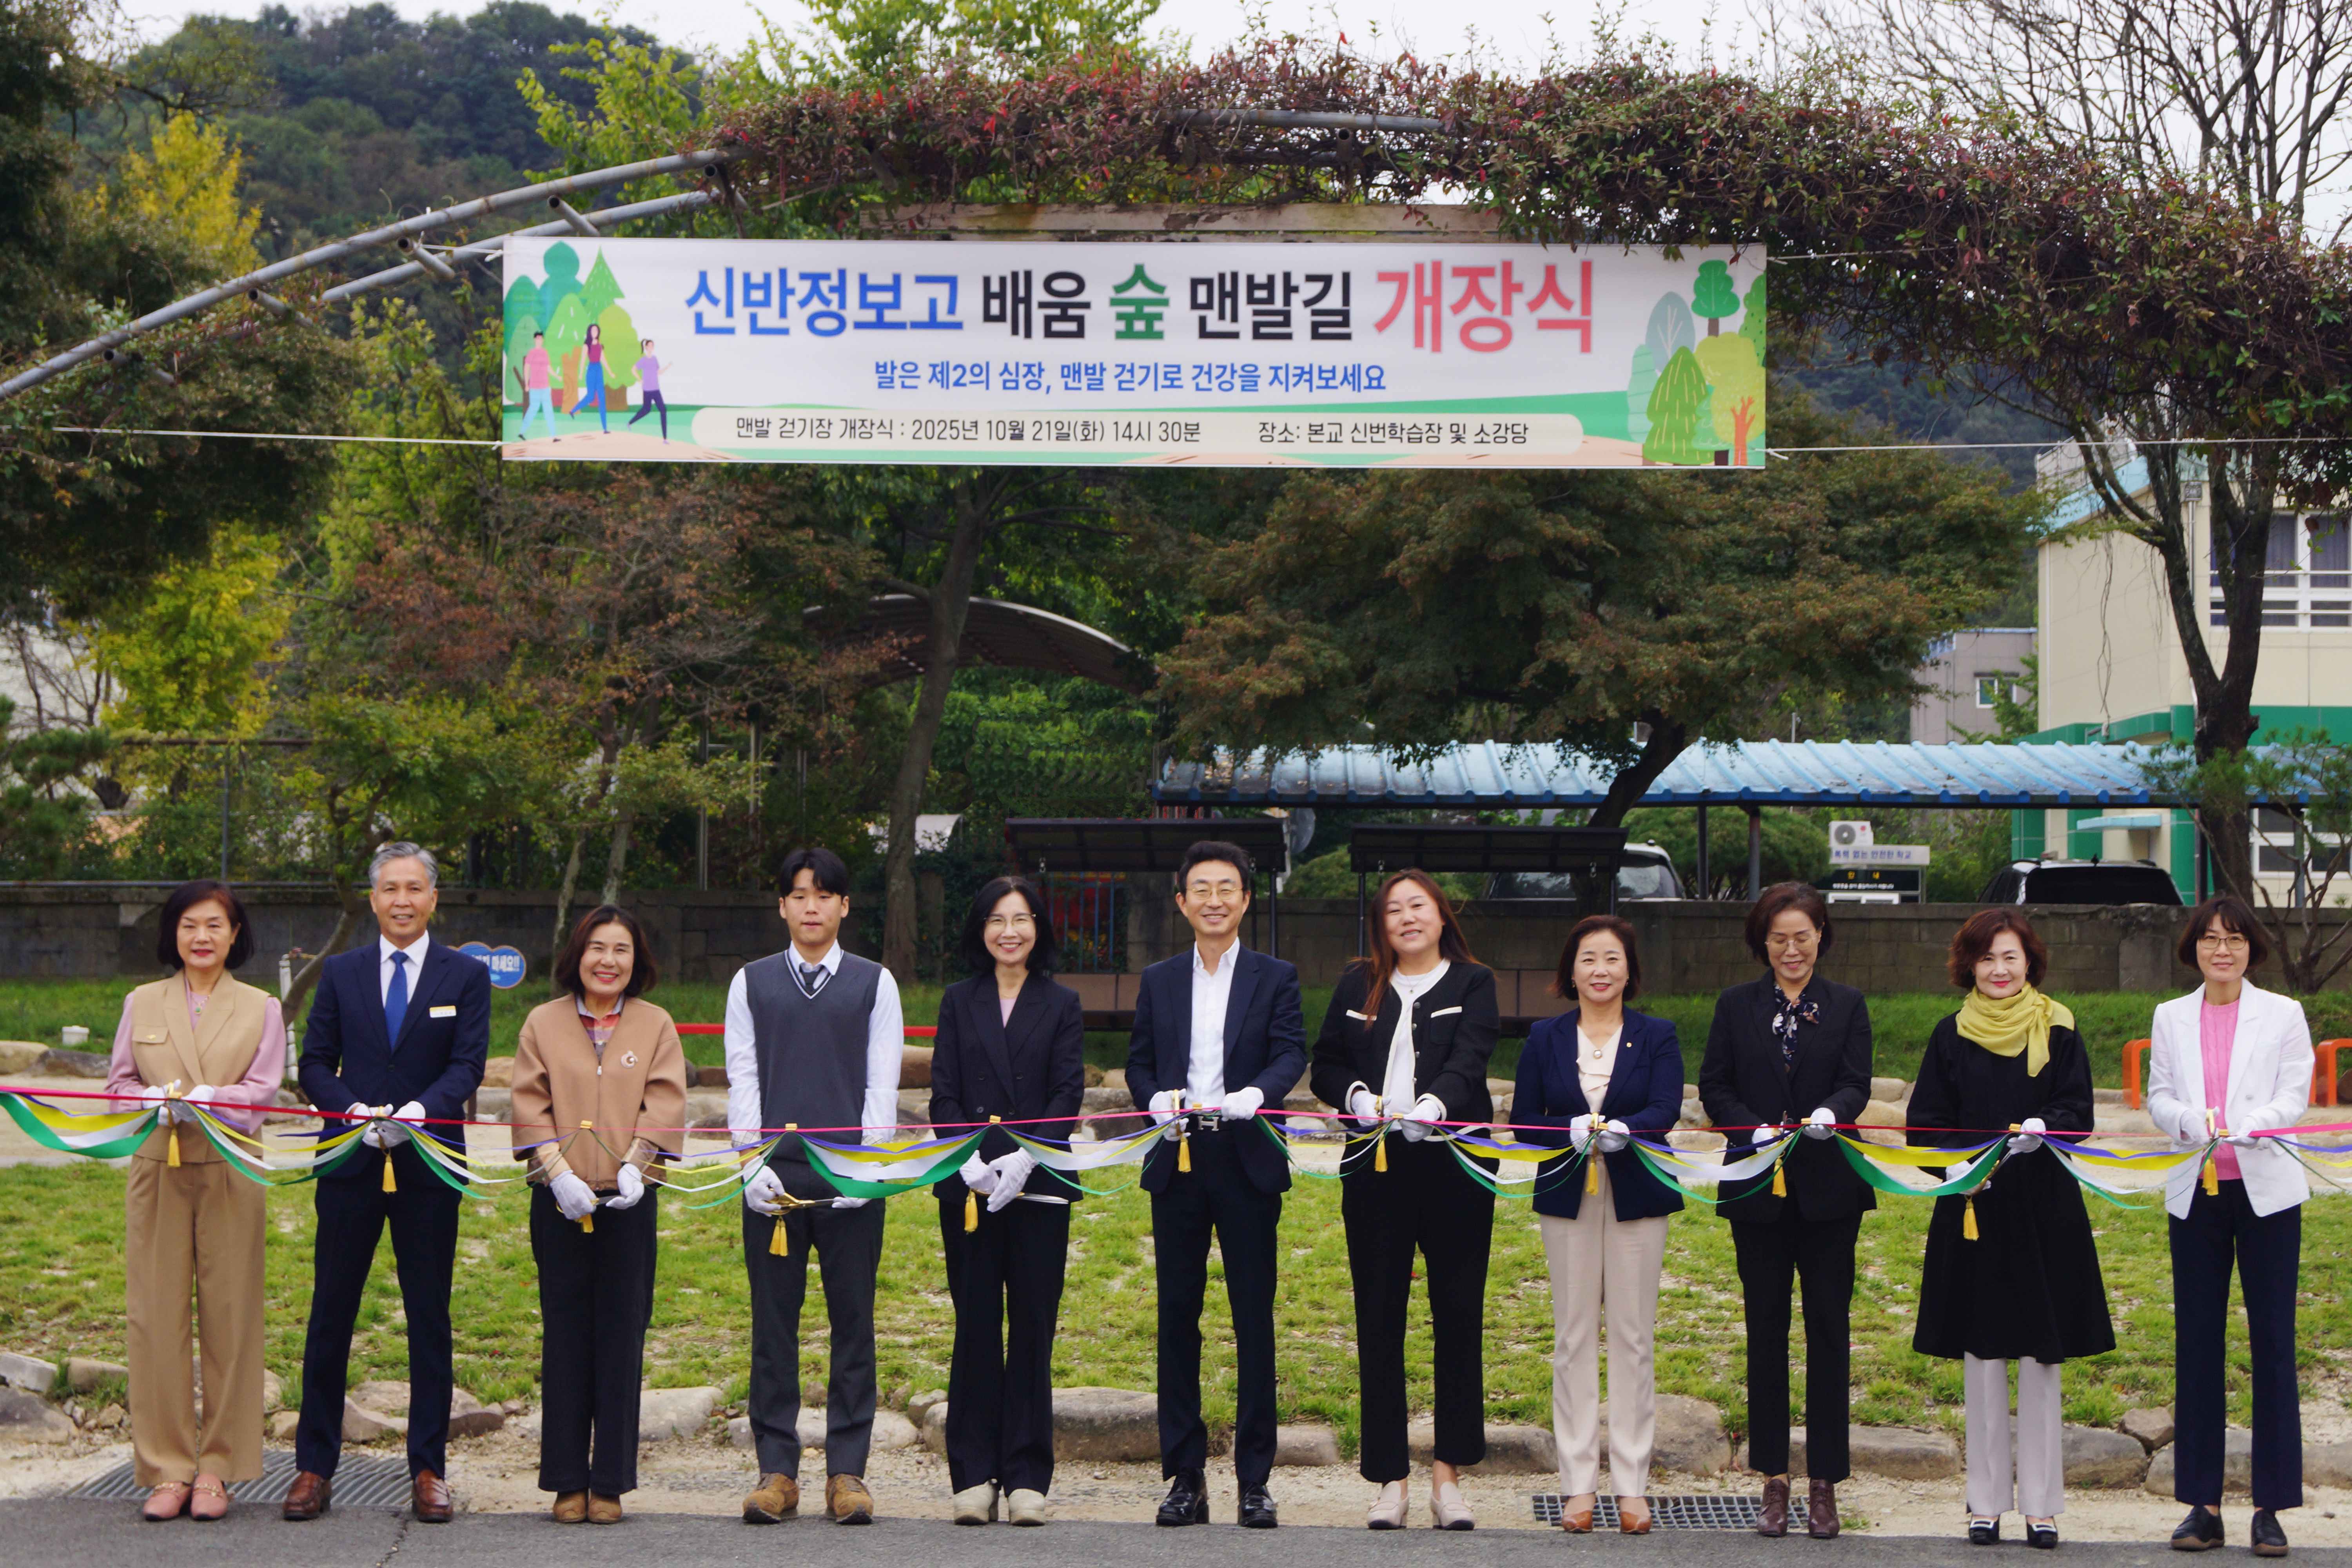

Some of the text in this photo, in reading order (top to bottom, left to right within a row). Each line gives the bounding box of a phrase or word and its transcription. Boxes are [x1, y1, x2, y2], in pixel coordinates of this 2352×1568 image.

[685, 260, 1593, 354] 신반정보고 배움 숲 맨발길 개장식
[875, 360, 1387, 395] 발은 제2의 심장, 맨발 걷기로 건강을 지켜보세요
[737, 418, 772, 439] 맨발
[779, 418, 833, 439] 걷기장
[840, 419, 893, 440] 개장식
[912, 419, 979, 441] 2025년
[987, 420, 1025, 441] 10월
[1033, 421, 1105, 442] 21일(화)
[1113, 421, 1151, 442] 14시
[1159, 421, 1201, 443] 30분
[1259, 422, 1529, 445] 장소: 본교 신번학습장 및 소강당
